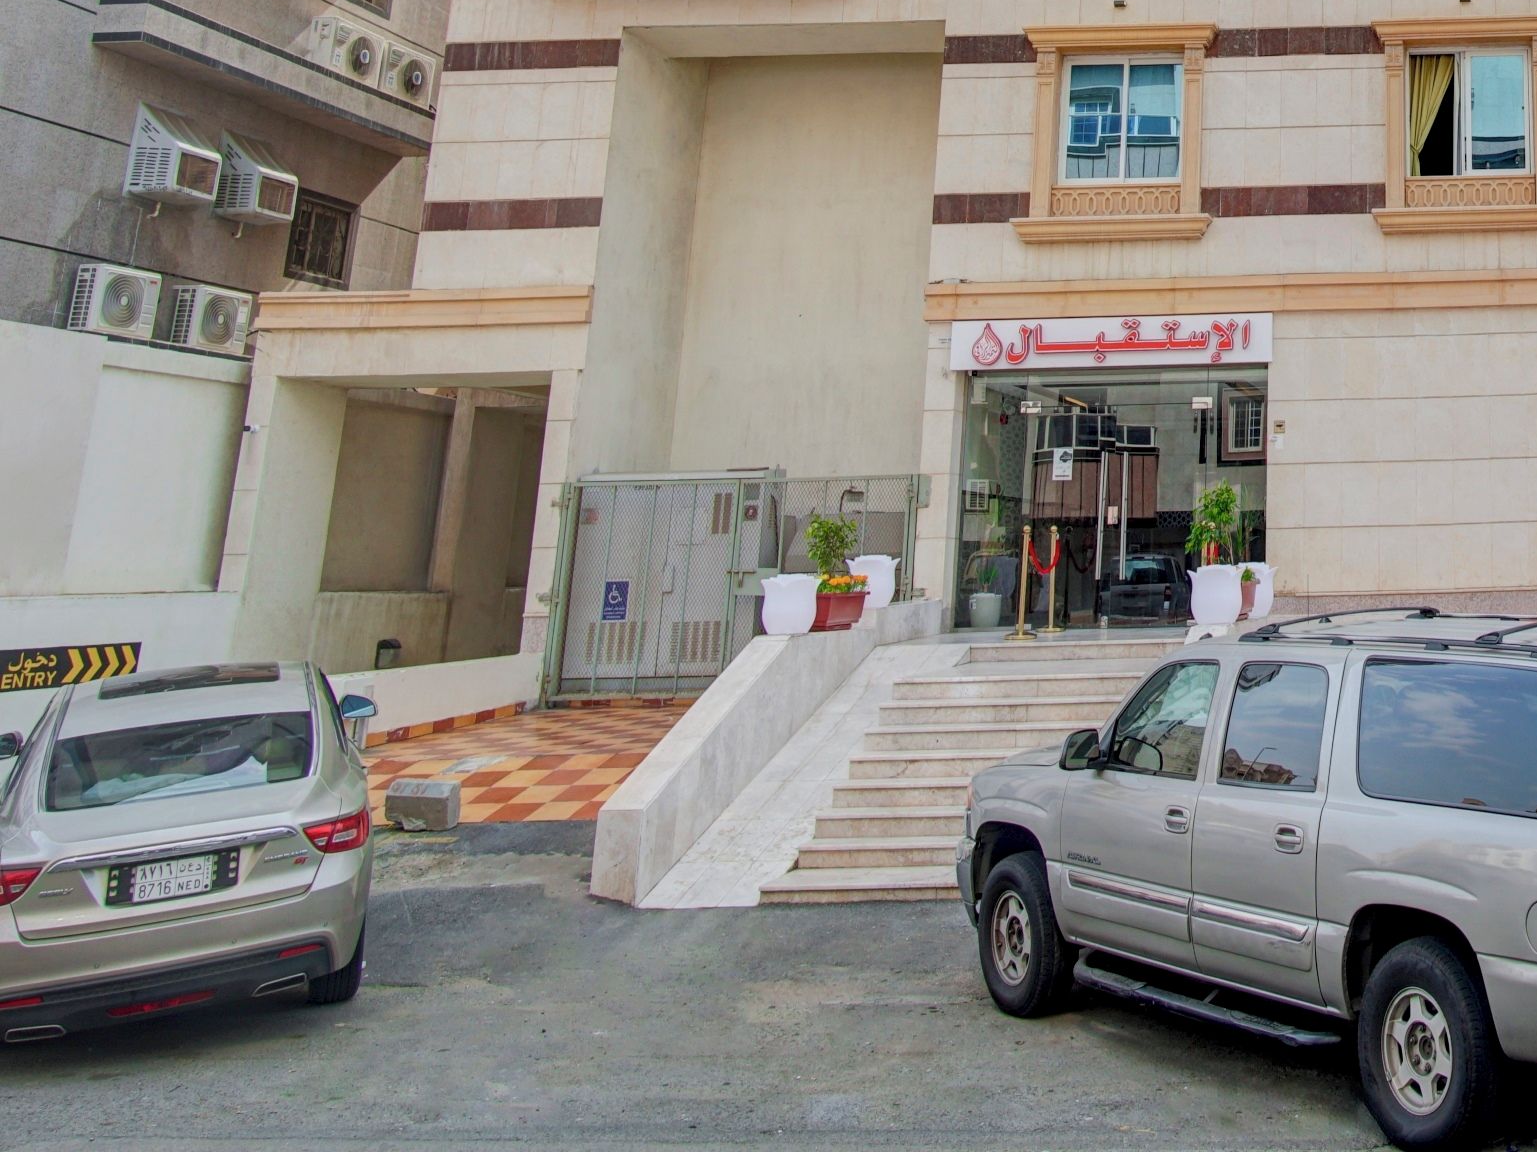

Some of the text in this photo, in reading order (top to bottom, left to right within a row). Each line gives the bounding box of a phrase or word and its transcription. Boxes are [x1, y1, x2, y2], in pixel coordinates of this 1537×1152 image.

[1005, 318, 1251, 364] الإستقبال
[8, 651, 57, 674] دخول
[0, 670, 57, 689] ENTRY
[138, 878, 201, 900] 8716 NED
